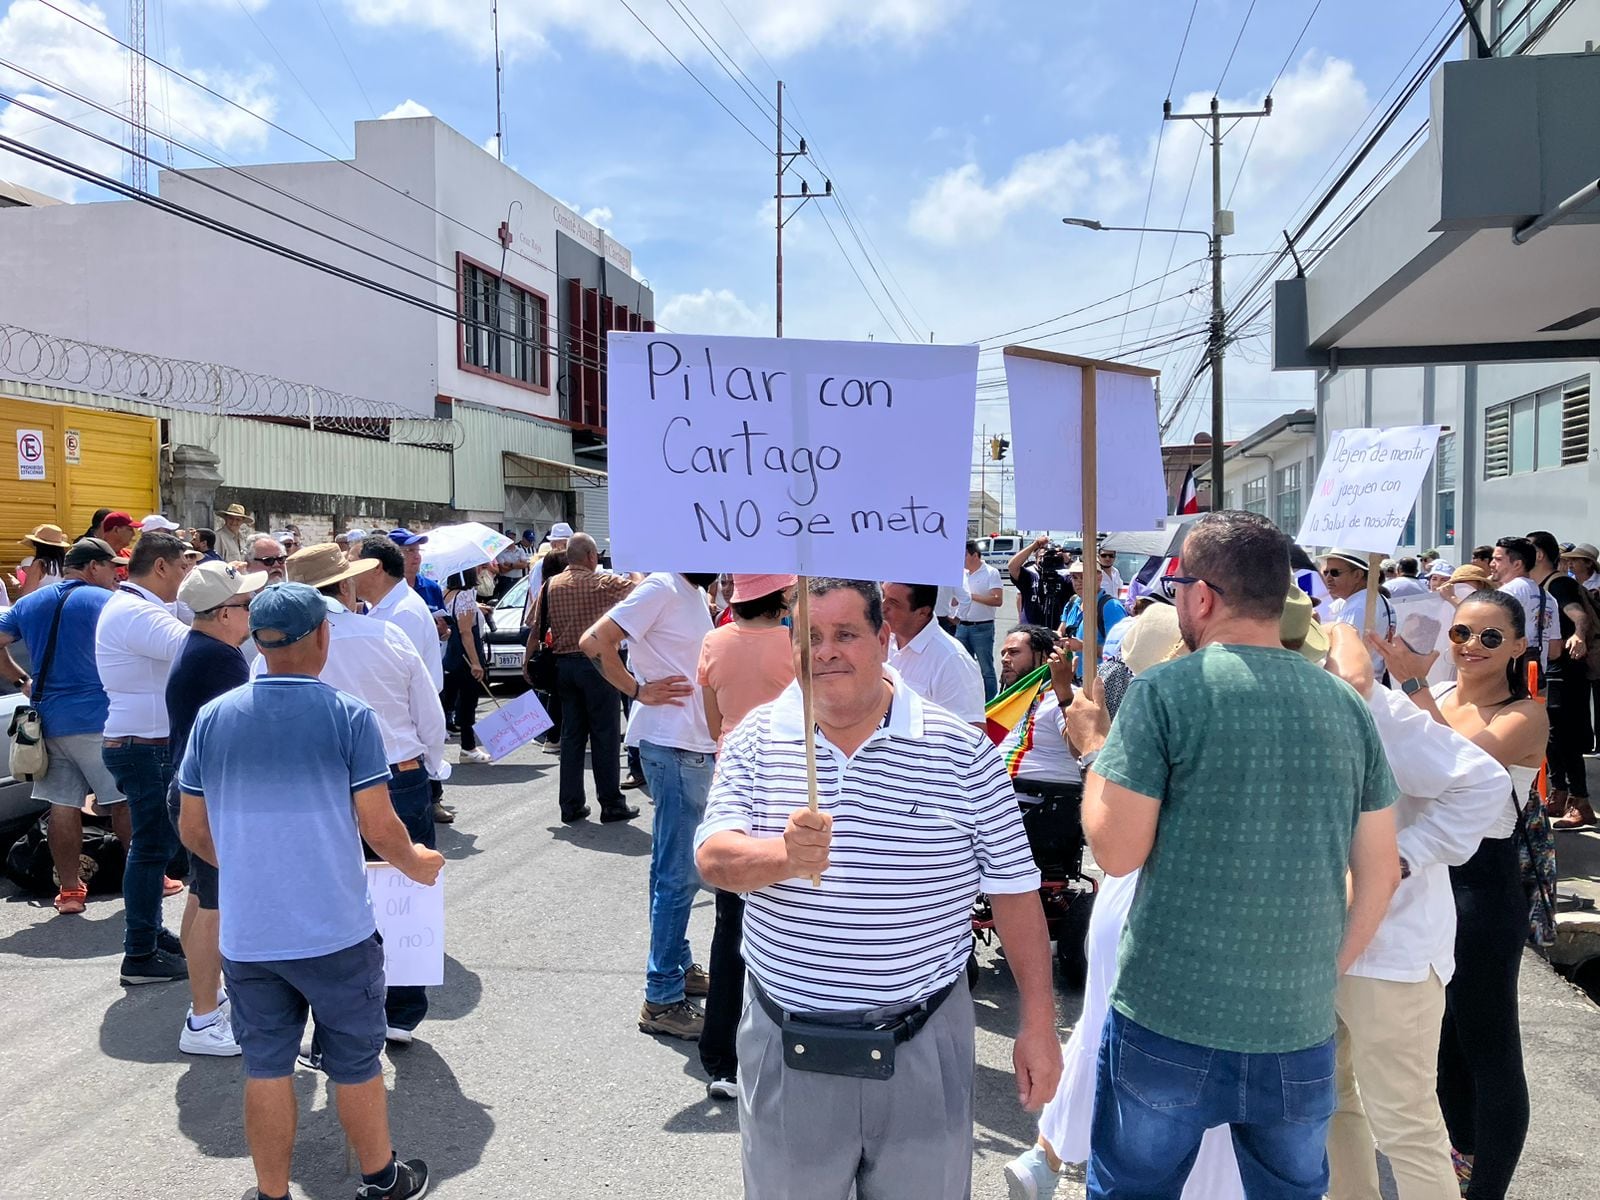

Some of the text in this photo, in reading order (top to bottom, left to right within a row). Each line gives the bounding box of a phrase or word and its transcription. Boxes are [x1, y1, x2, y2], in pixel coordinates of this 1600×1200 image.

[647, 341, 892, 408] Pilar con
[662, 416, 842, 506] Cartago
[1333, 436, 1430, 472] Dejen de mentir
[1320, 479, 1335, 497] NO
[1380, 480, 1401, 492] con
[693, 496, 949, 542] NO se meta
[1309, 508, 1406, 532] la Salud de nosotros
